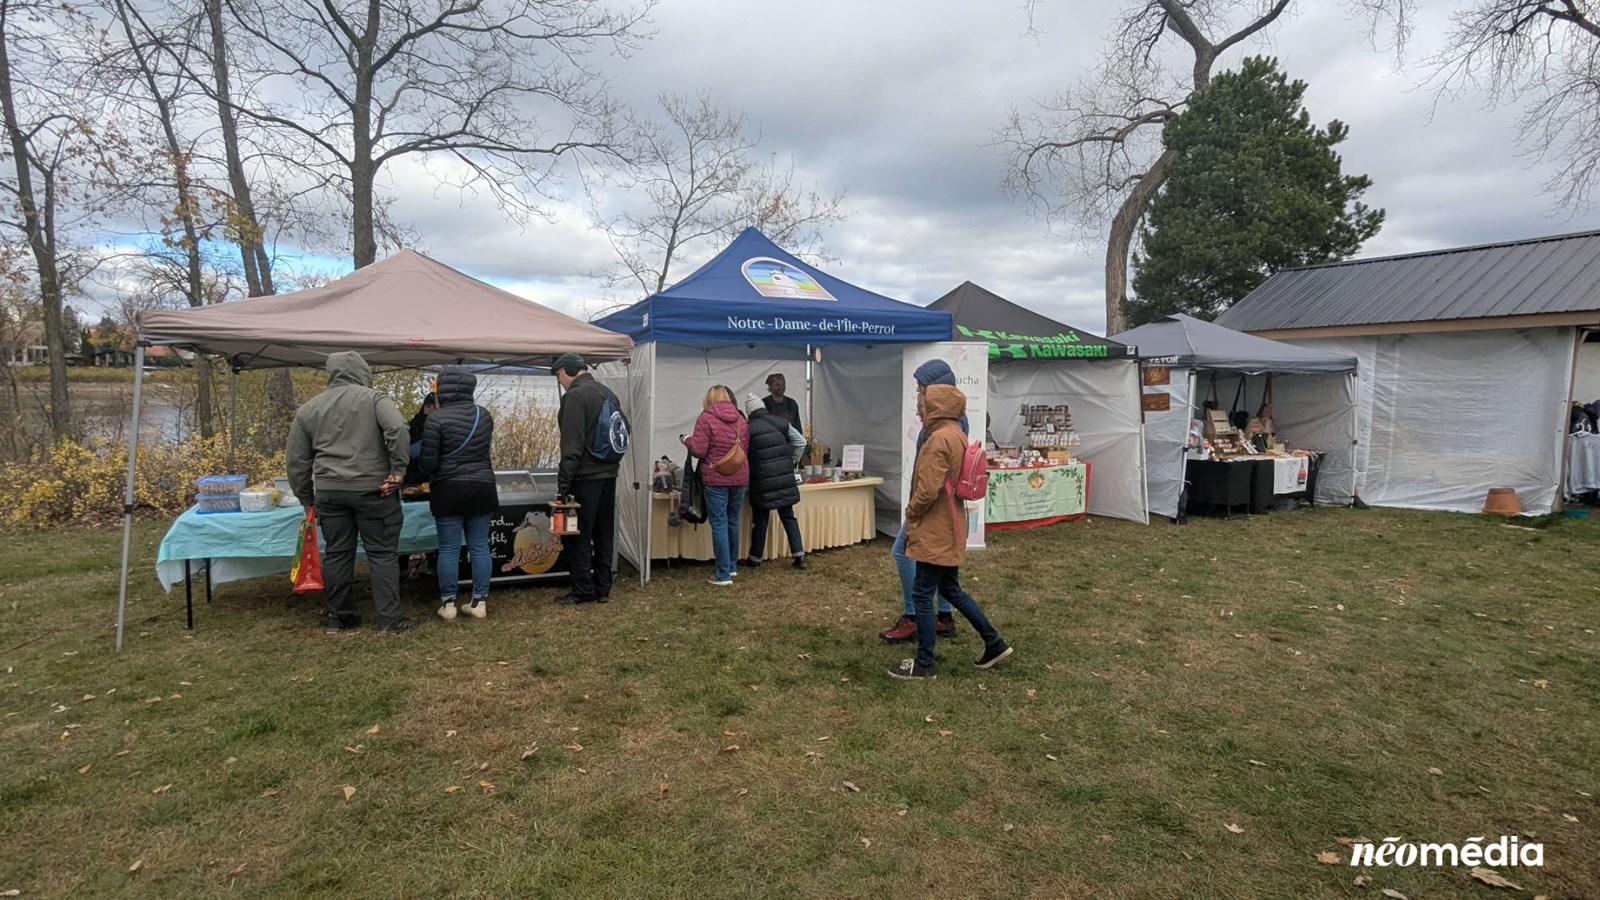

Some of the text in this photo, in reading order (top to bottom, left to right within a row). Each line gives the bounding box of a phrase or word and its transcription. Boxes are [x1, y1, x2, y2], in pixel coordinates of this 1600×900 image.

[995, 331, 1080, 344] Kawasaki
[1029, 344, 1108, 358] Kawasaki
[956, 375, 979, 385] ucha
[488, 531, 508, 546] fit,
